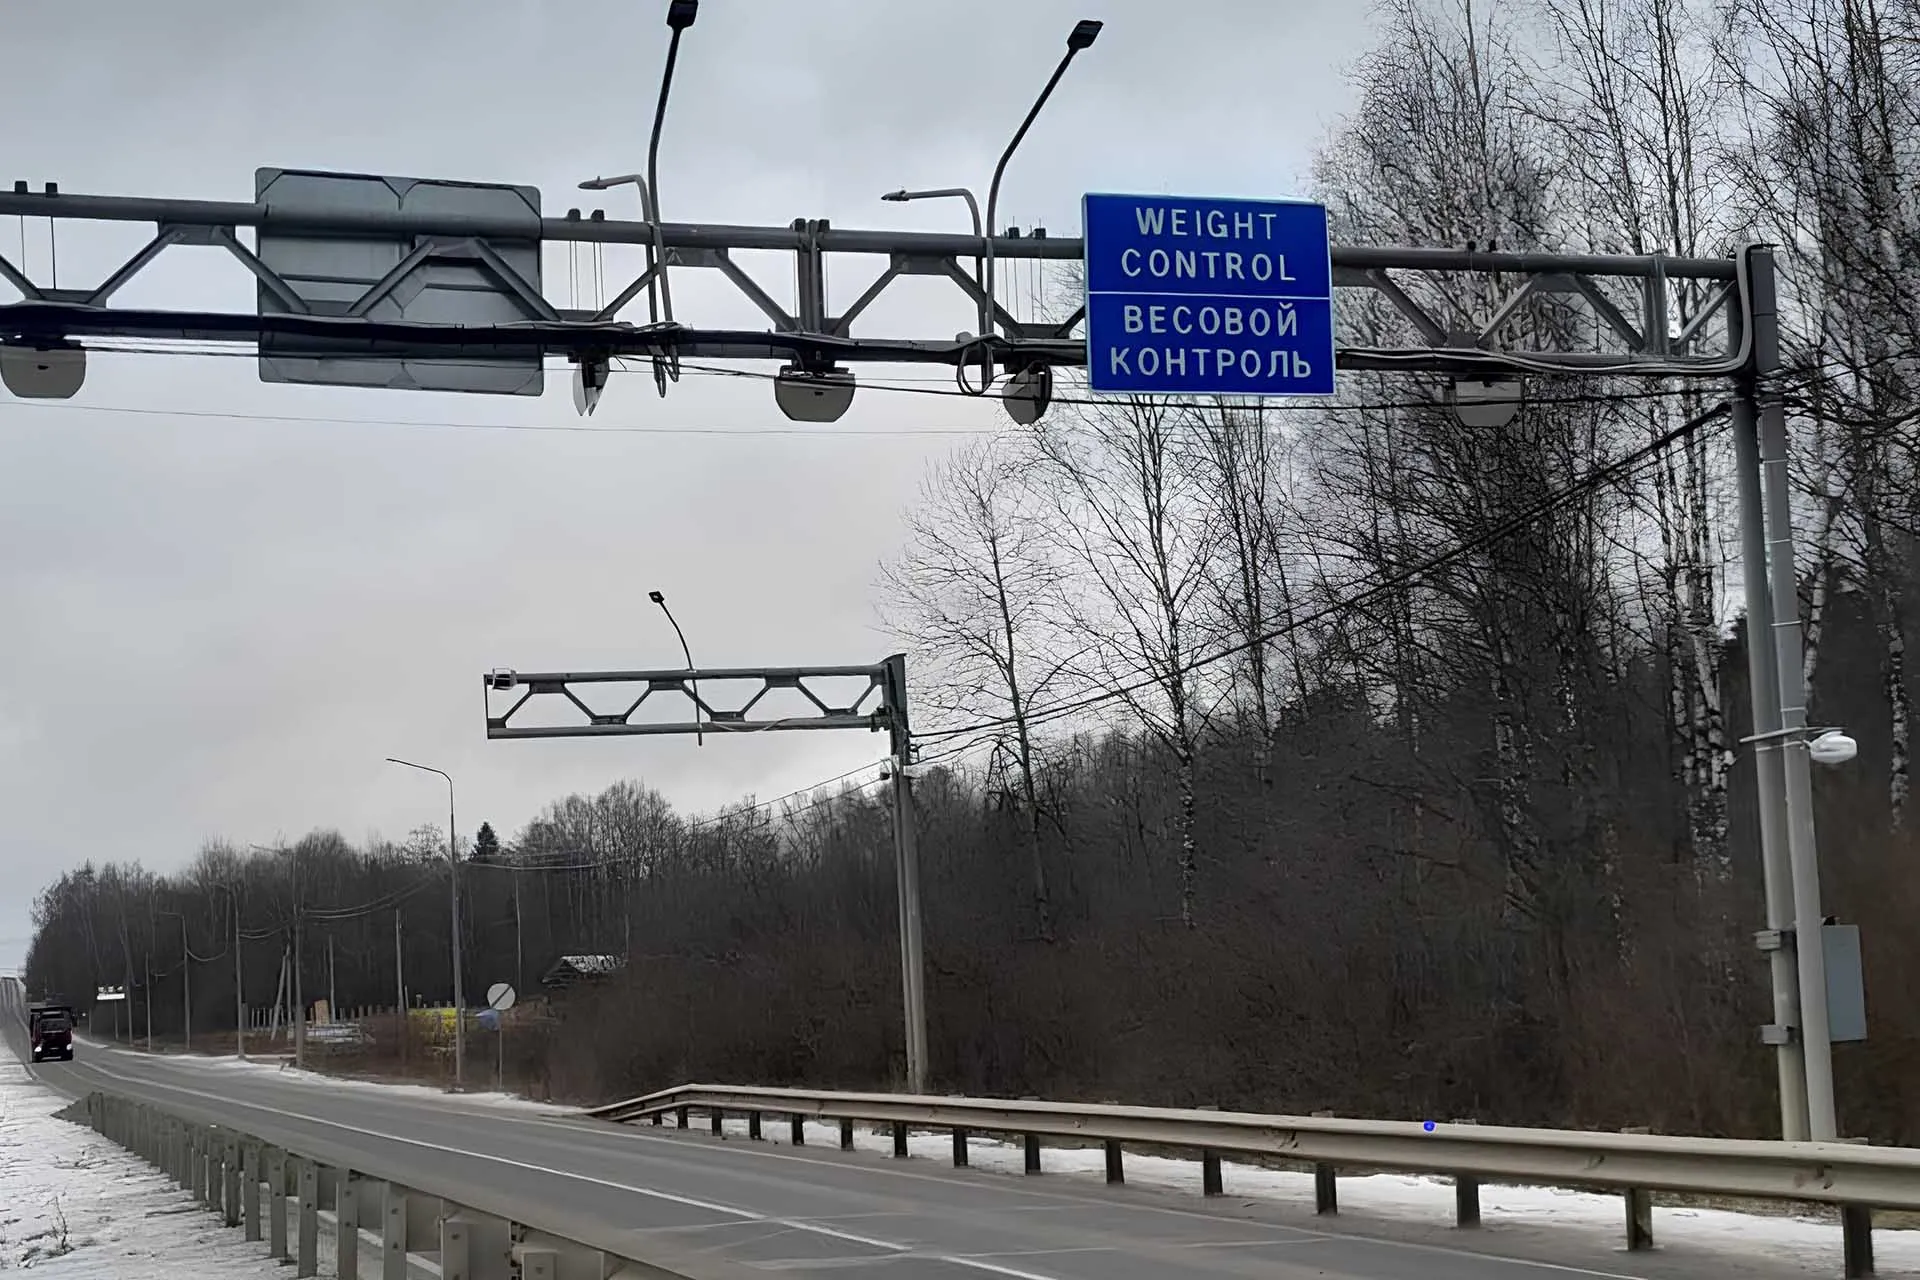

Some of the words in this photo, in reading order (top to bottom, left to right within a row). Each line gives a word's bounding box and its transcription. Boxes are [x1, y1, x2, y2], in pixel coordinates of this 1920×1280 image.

[1136, 207, 1277, 240] WEIGHT
[1121, 248, 1297, 281] CONTROL
[1123, 302, 1297, 337] ВЕСОВОЙ
[1110, 346, 1312, 378] КОНТРОЛЬ
